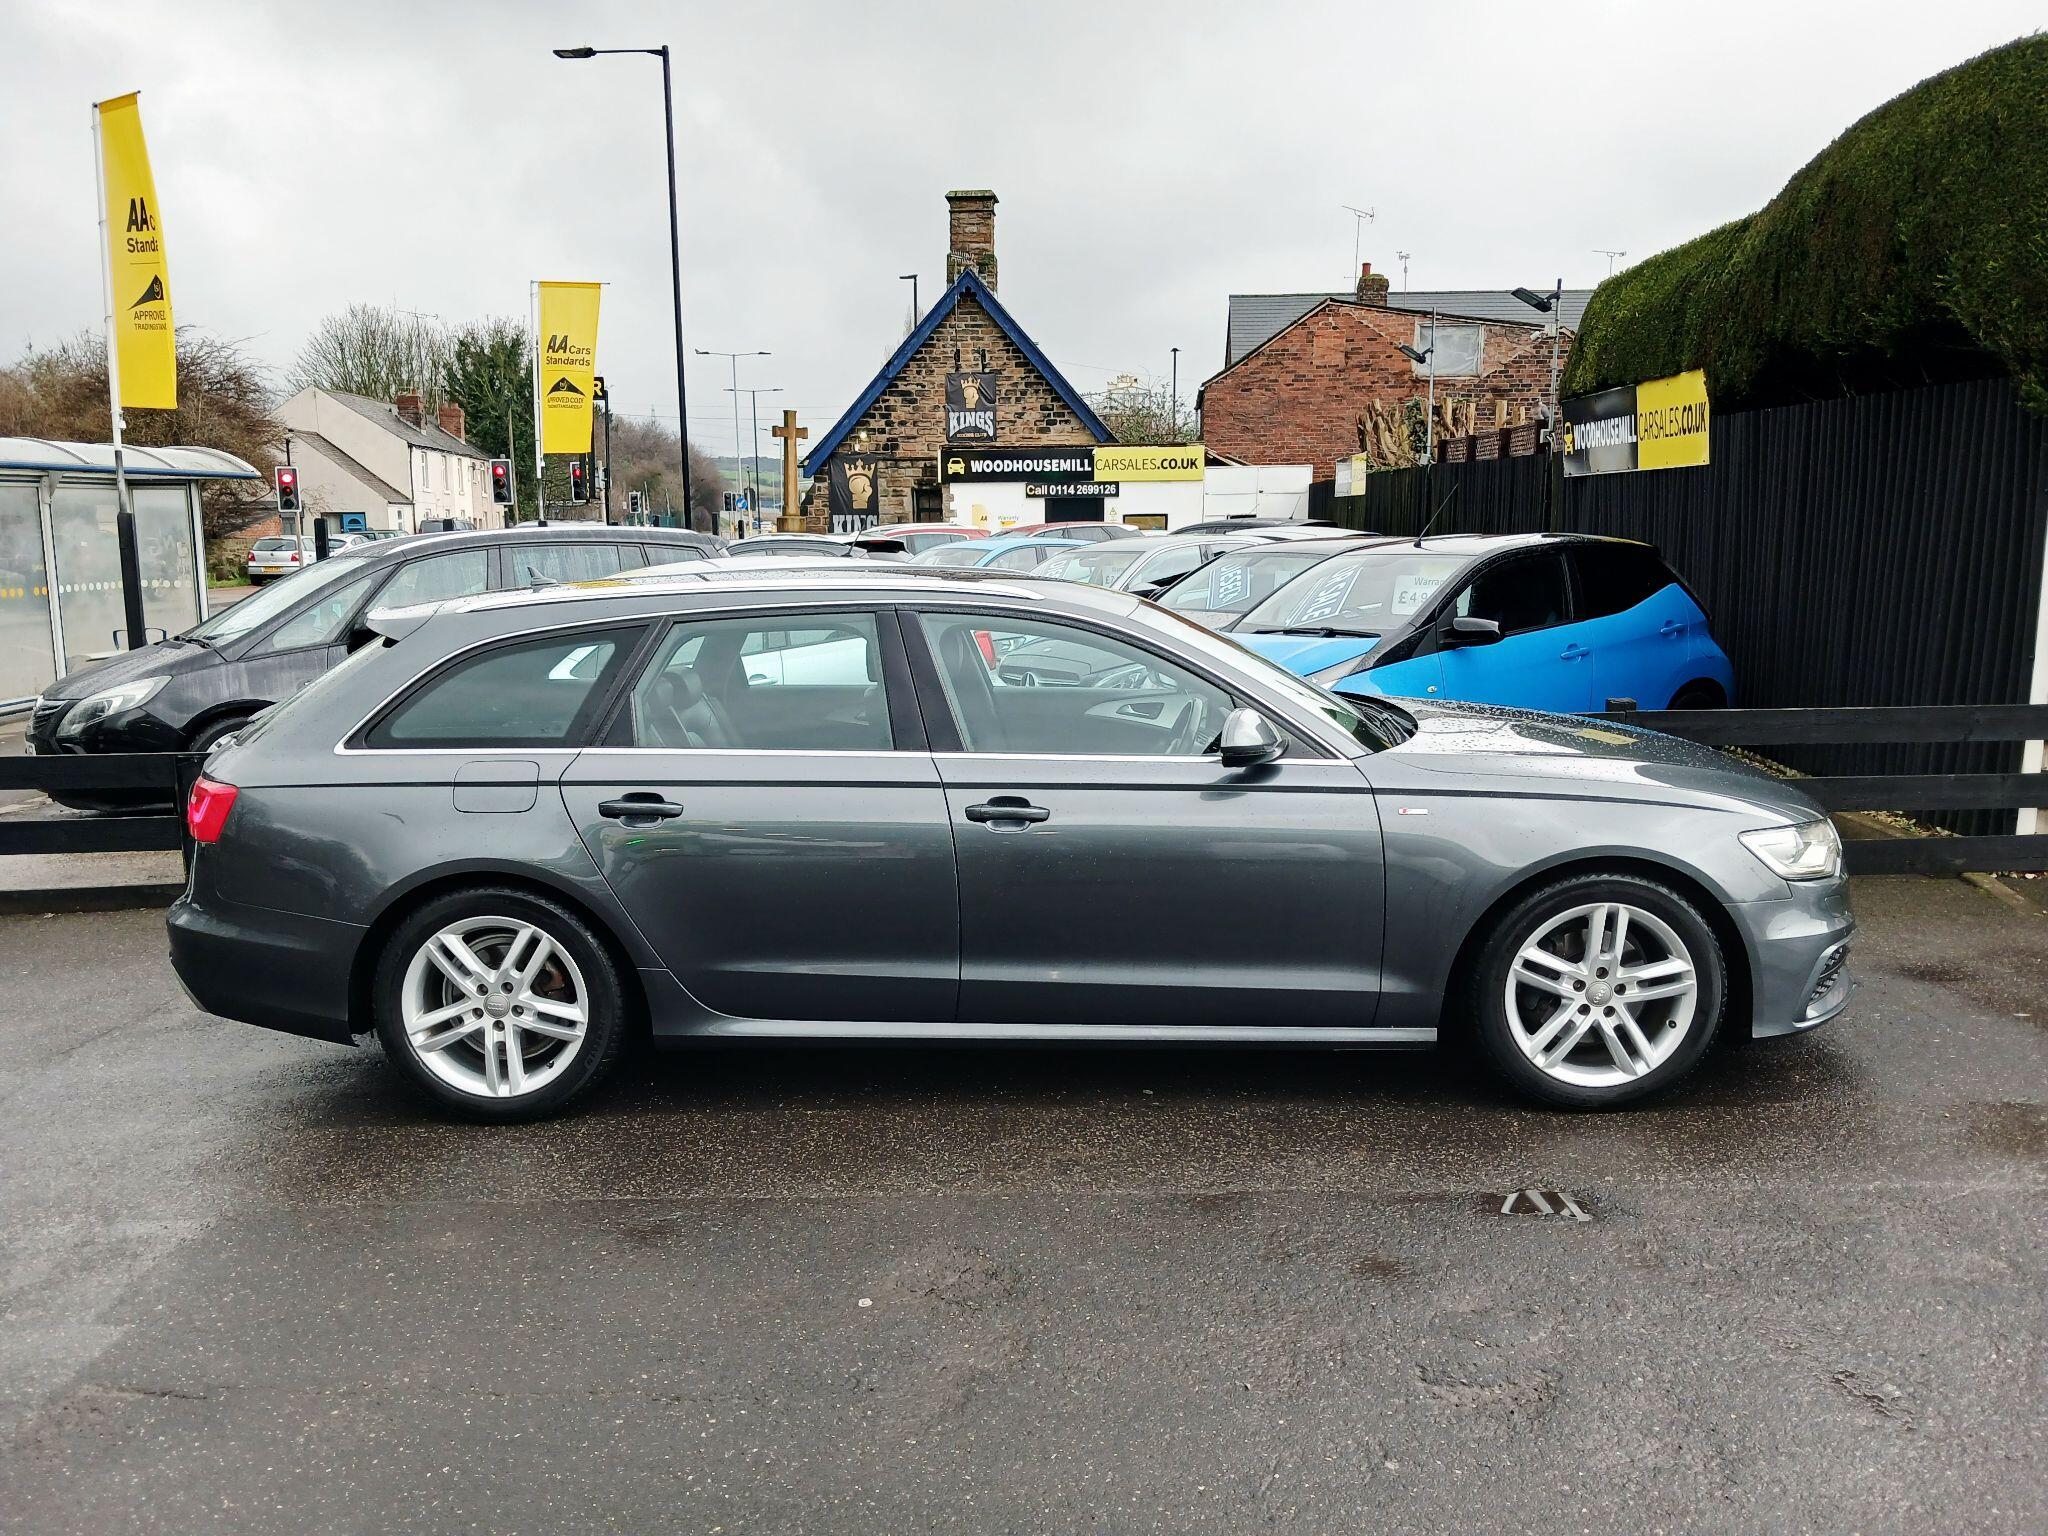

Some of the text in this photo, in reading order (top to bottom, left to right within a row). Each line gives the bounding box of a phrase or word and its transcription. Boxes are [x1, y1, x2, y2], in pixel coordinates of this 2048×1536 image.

[126, 196, 150, 232] AA
[546, 334, 591, 355] AA Cars
[545, 356, 591, 367] Standards
[948, 410, 994, 438] KINGS
[1573, 401, 1707, 450] WOODHOUSEMILL CARSALES.CO.UK
[970, 457, 1199, 473] WOODHOUSEMILL CARSALES.CO.UK
[1026, 484, 1116, 495] Call 0114 2699126
